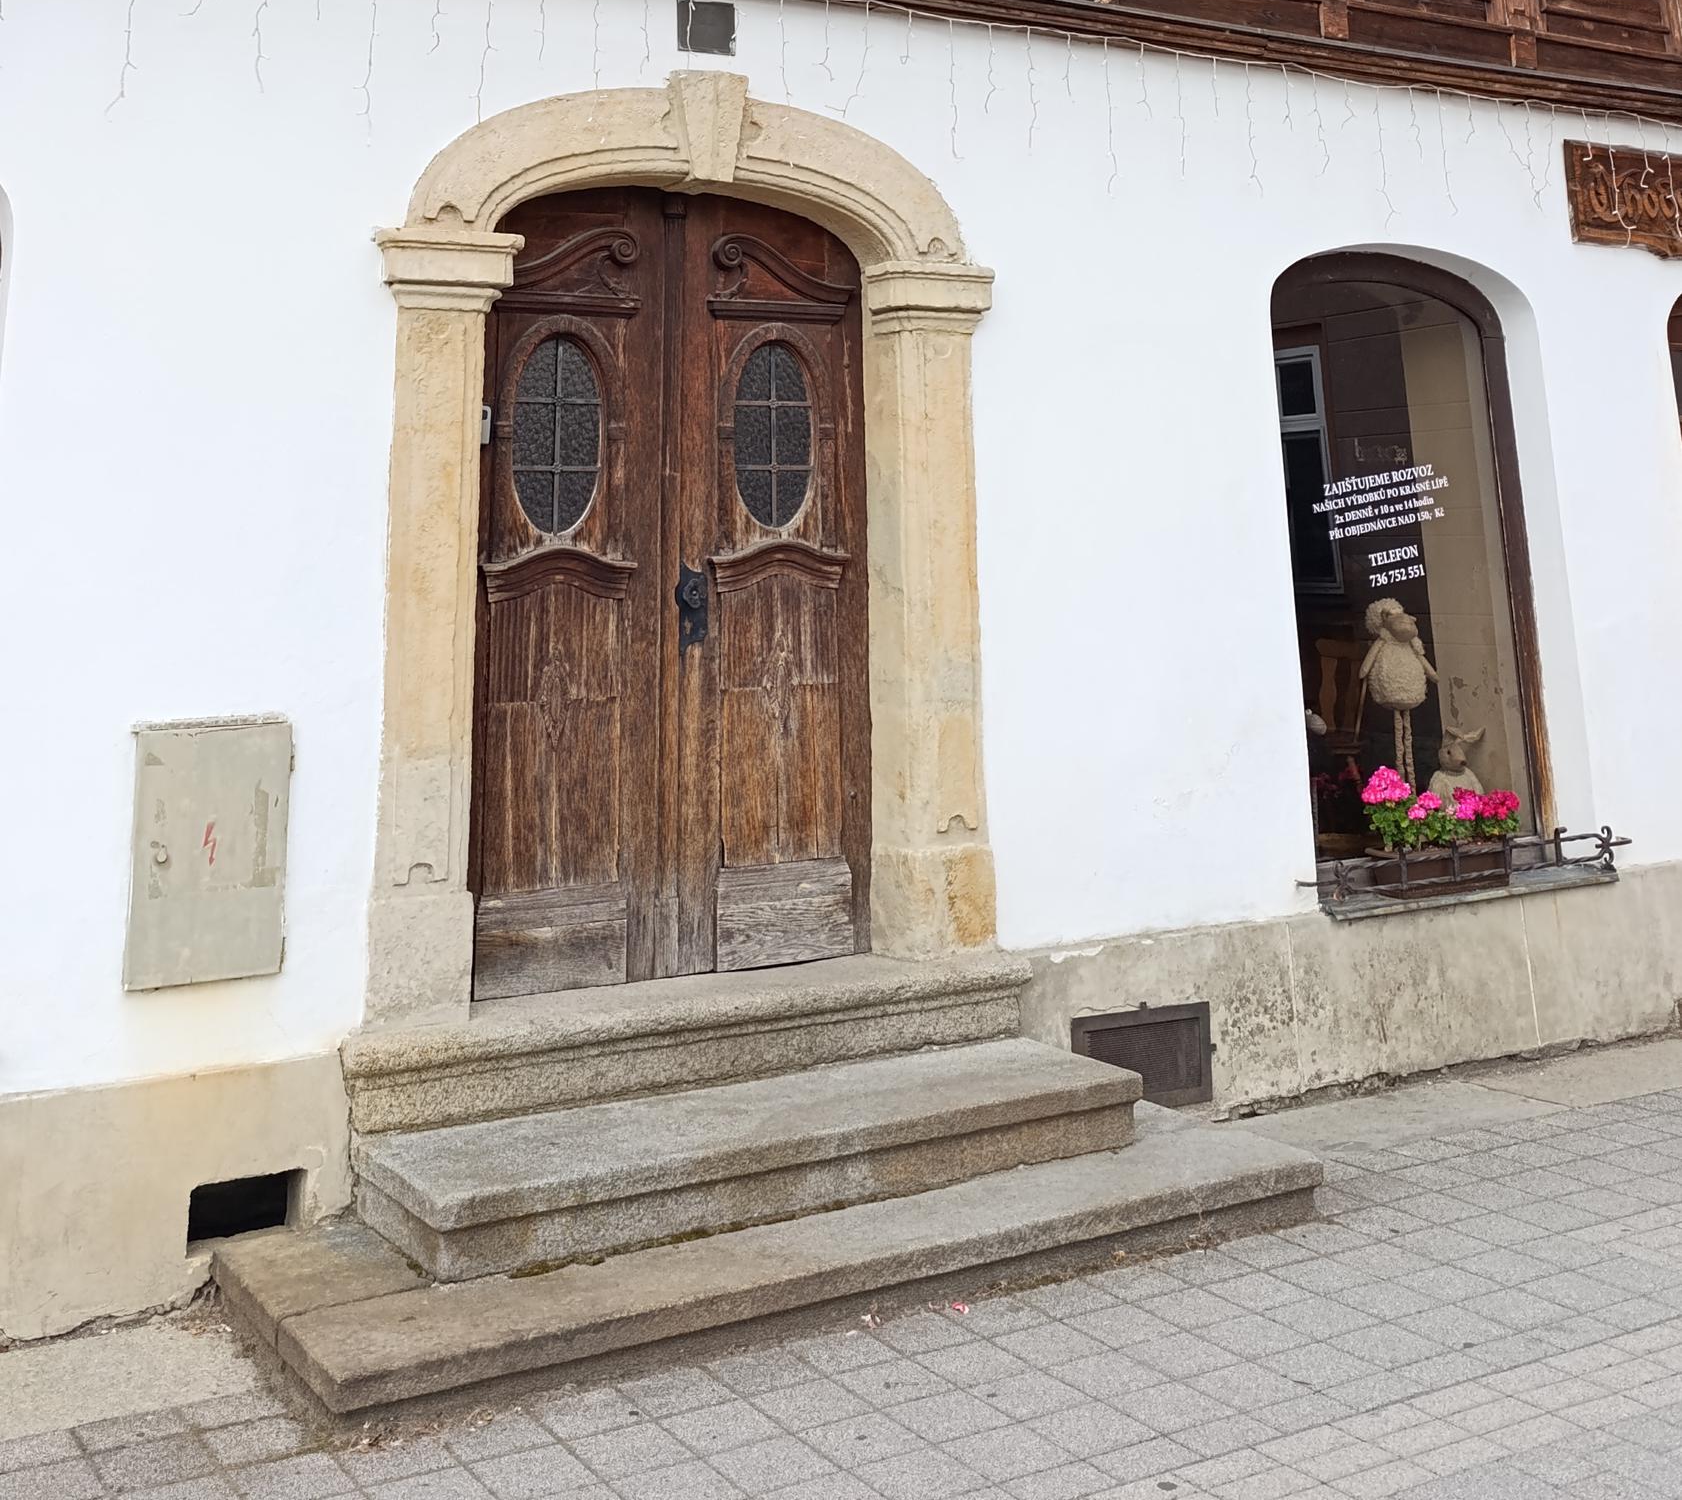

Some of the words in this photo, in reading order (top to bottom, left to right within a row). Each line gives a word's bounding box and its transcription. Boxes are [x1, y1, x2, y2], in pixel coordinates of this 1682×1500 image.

[1323, 472, 1391, 496] ZAJIŠŤUJEME
[1391, 464, 1433, 483] ROZVOZ
[1312, 496, 1345, 514] NAŠICH
[1346, 488, 1386, 508] VÝROBKŮ
[1387, 488, 1399, 498] PO
[1399, 481, 1431, 496] KRÁSNÉ
[1334, 514, 1344, 524] 2x
[1345, 506, 1374, 522] DENNĚ
[1380, 504, 1389, 514] 10
[1389, 505, 1395, 513] a
[1395, 503, 1403, 511] ve
[1404, 500, 1413, 510] 14
[1413, 496, 1434, 508] hodin
[1329, 527, 1344, 540] PŘI
[1344, 514, 1398, 537] OBJEDNÁVCE
[1398, 512, 1416, 526] NAD
[1434, 507, 1445, 518] Kč
[1369, 545, 1419, 566] TELEFON
[1370, 572, 1388, 587] 736
[1389, 568, 1407, 583] 752
[1408, 564, 1425, 579] 551
